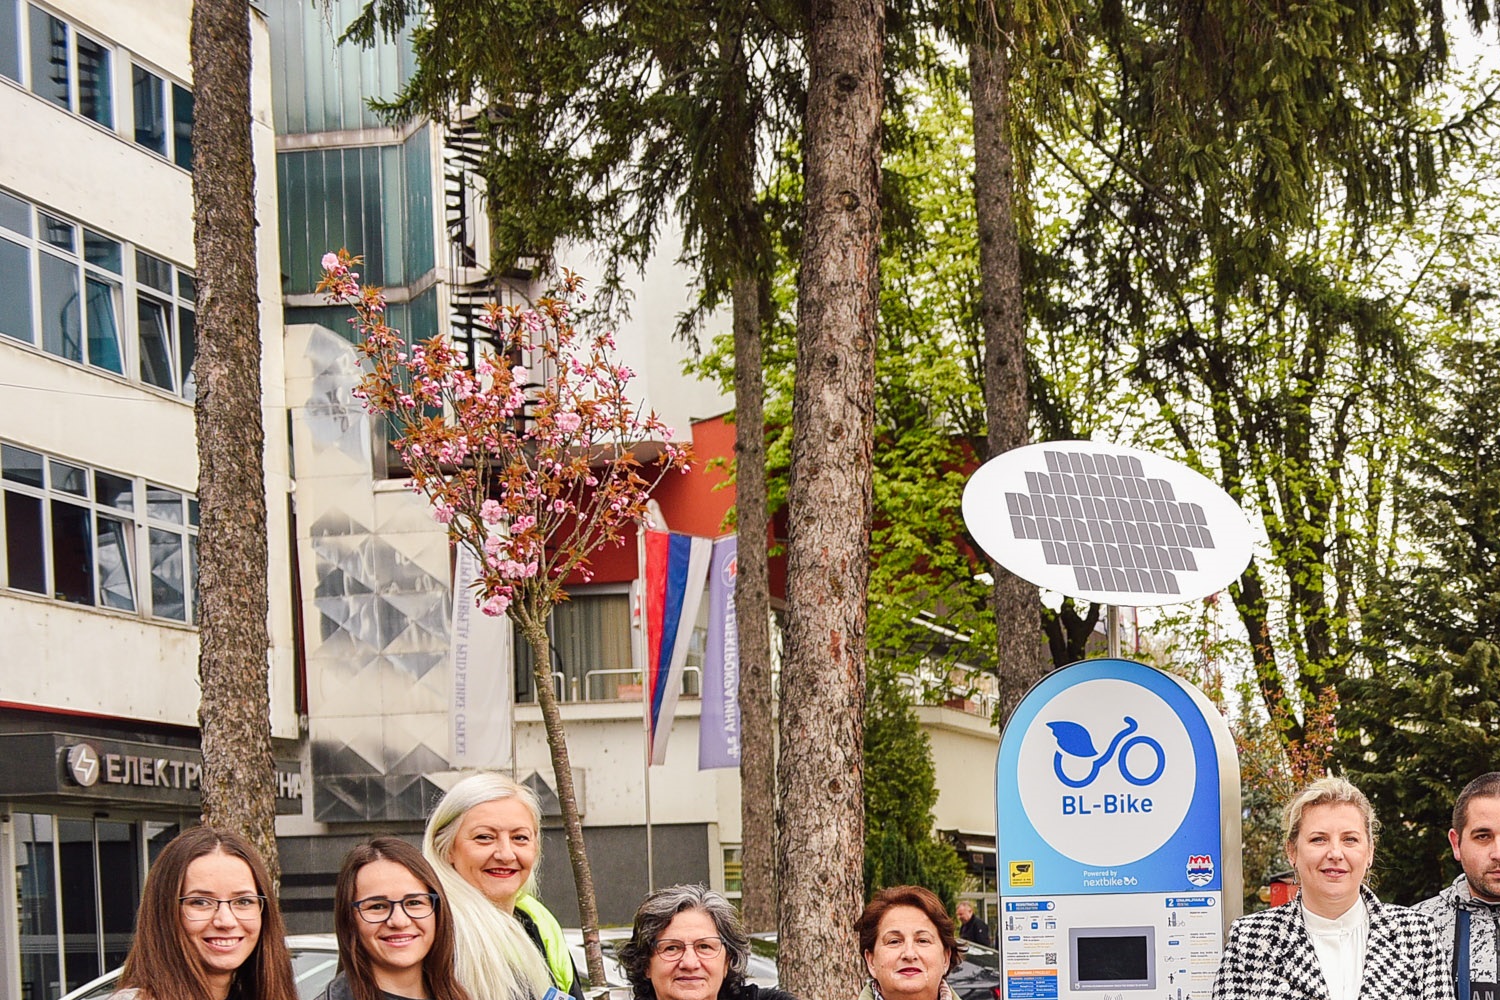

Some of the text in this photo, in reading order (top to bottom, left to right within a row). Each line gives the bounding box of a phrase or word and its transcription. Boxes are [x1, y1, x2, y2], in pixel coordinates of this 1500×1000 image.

[1062, 793, 1153, 815] BL-Bike
[1083, 876, 1123, 887] nextbike
[1008, 903, 1012, 911] 1
[1168, 898, 1174, 907] 2
